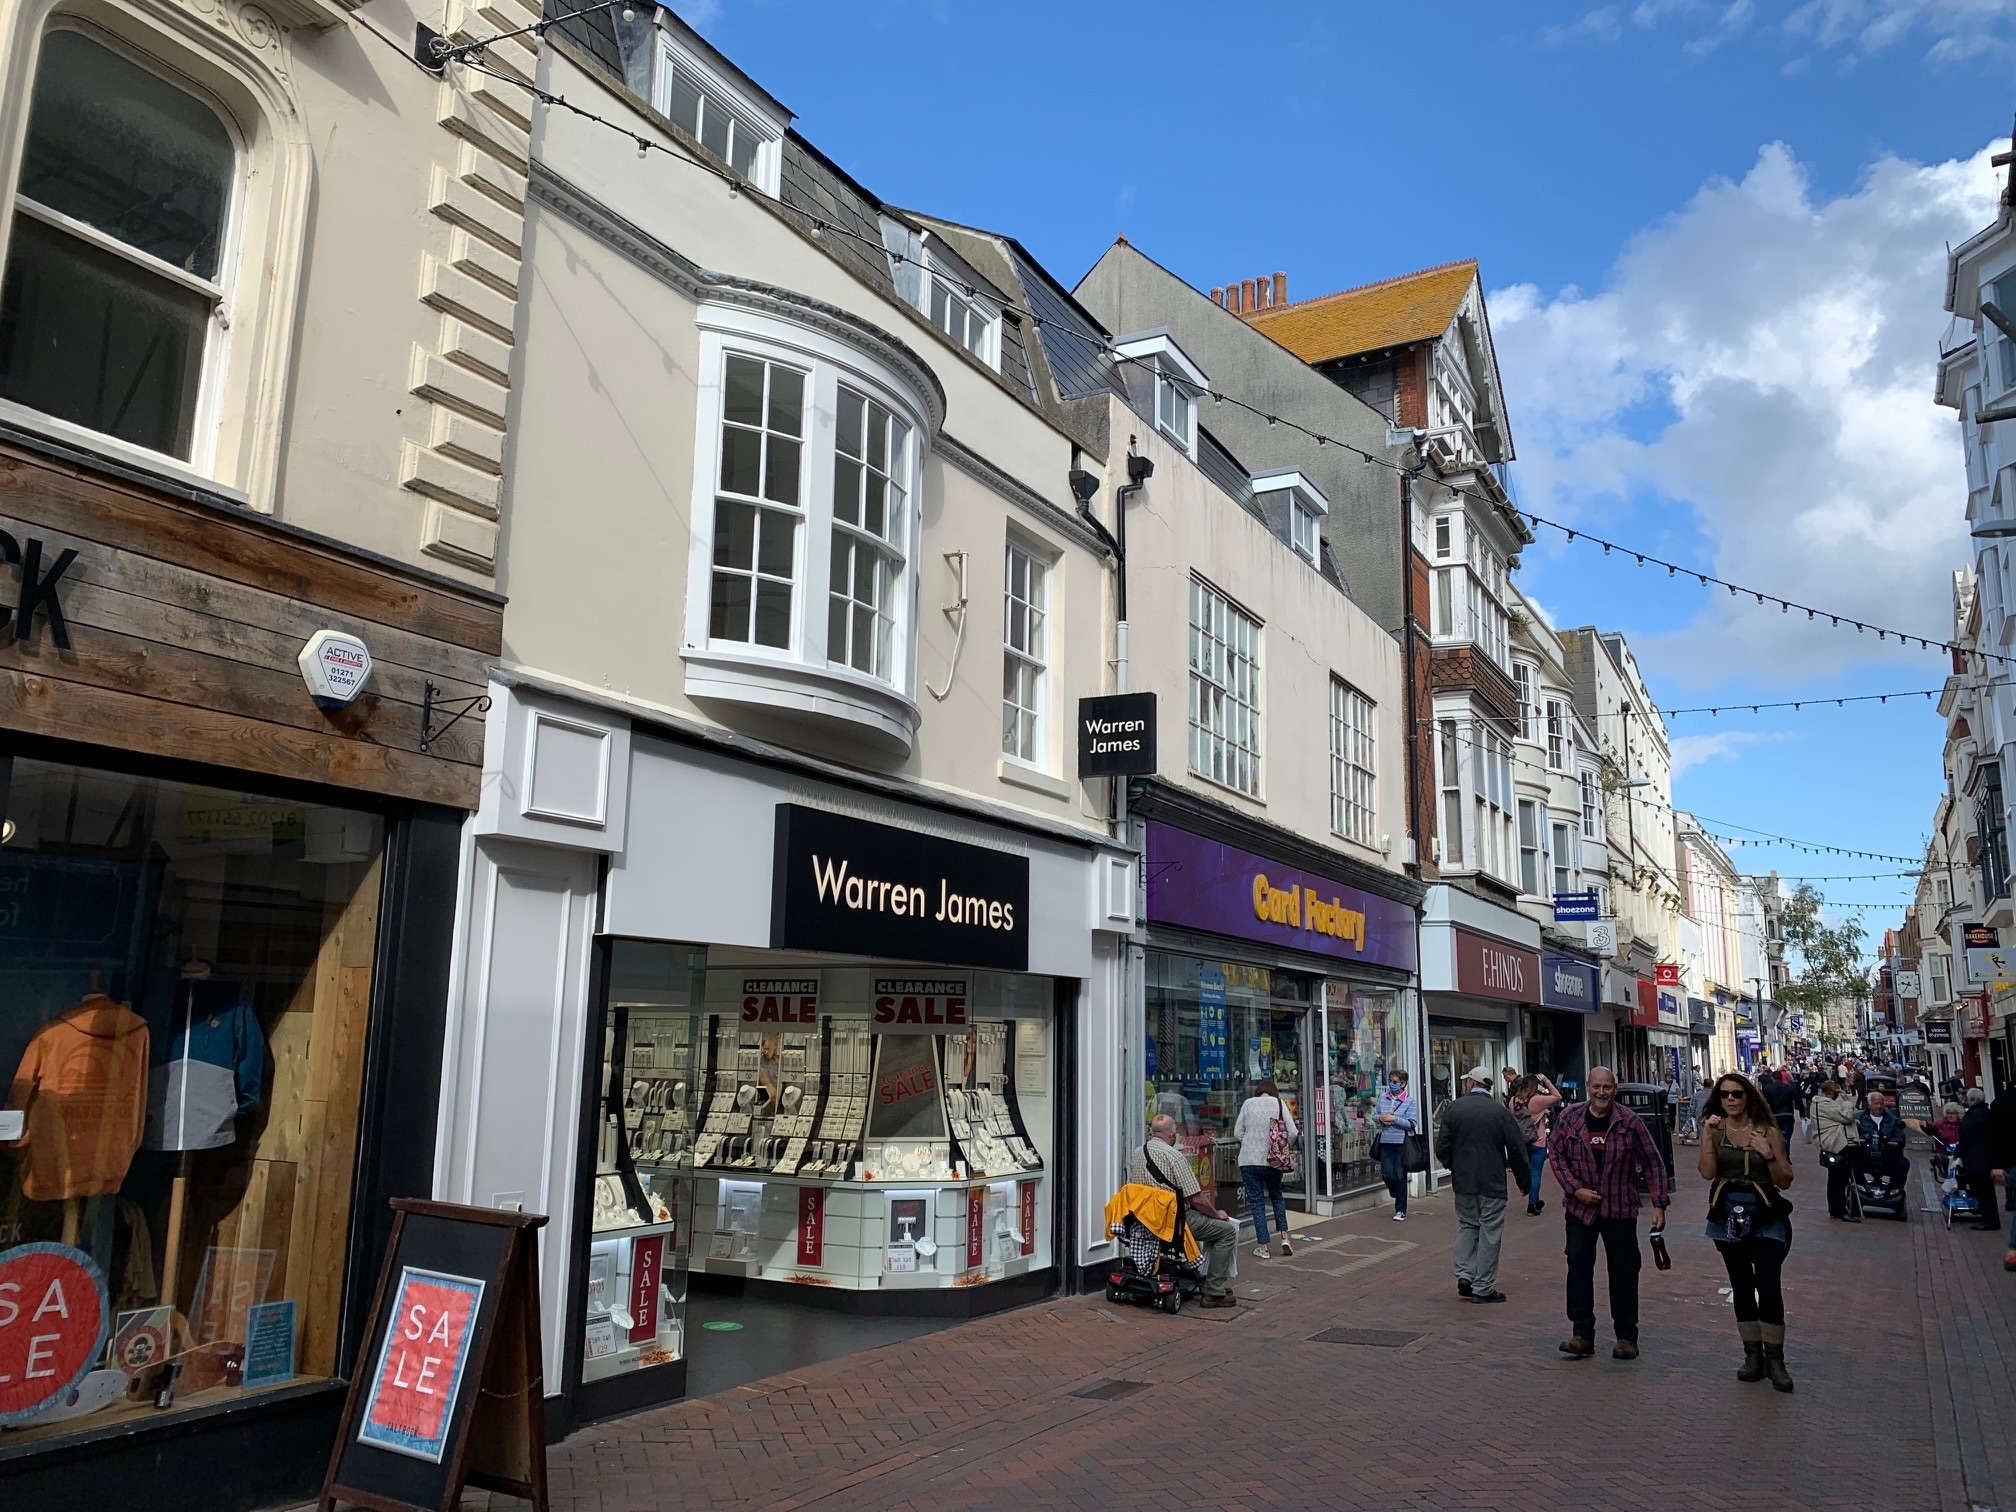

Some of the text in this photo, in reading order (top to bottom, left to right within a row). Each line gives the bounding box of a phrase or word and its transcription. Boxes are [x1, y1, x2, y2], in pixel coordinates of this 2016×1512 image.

[326, 646, 364, 663] ACTIVE
[328, 674, 356, 686] 322567
[331, 667, 354, 678] 01271
[1085, 718, 1145, 735] Warren
[1089, 738, 1141, 754] James
[812, 854, 1014, 931] Warren James
[1253, 873, 1365, 952] Card Factory
[1556, 906, 1596, 914] shoezone
[1593, 926, 1610, 947] 3
[1482, 948, 1523, 993] F.HINDS
[1554, 965, 1584, 998] shoezone
[745, 981, 816, 993] CLEARANCE
[877, 981, 964, 995] CLEARANCE
[741, 996, 818, 1023] SALE
[873, 997, 967, 1025] SALE
[876, 1062, 932, 1087] clearance
[879, 1070, 937, 1106] SALE
[1590, 1136, 1606, 1144] ev
[805, 1197, 816, 1254] SALE
[971, 1199, 979, 1256] SALE
[638, 1250, 653, 1327] SALE
[385, 1420, 419, 1438] SALTROCK
